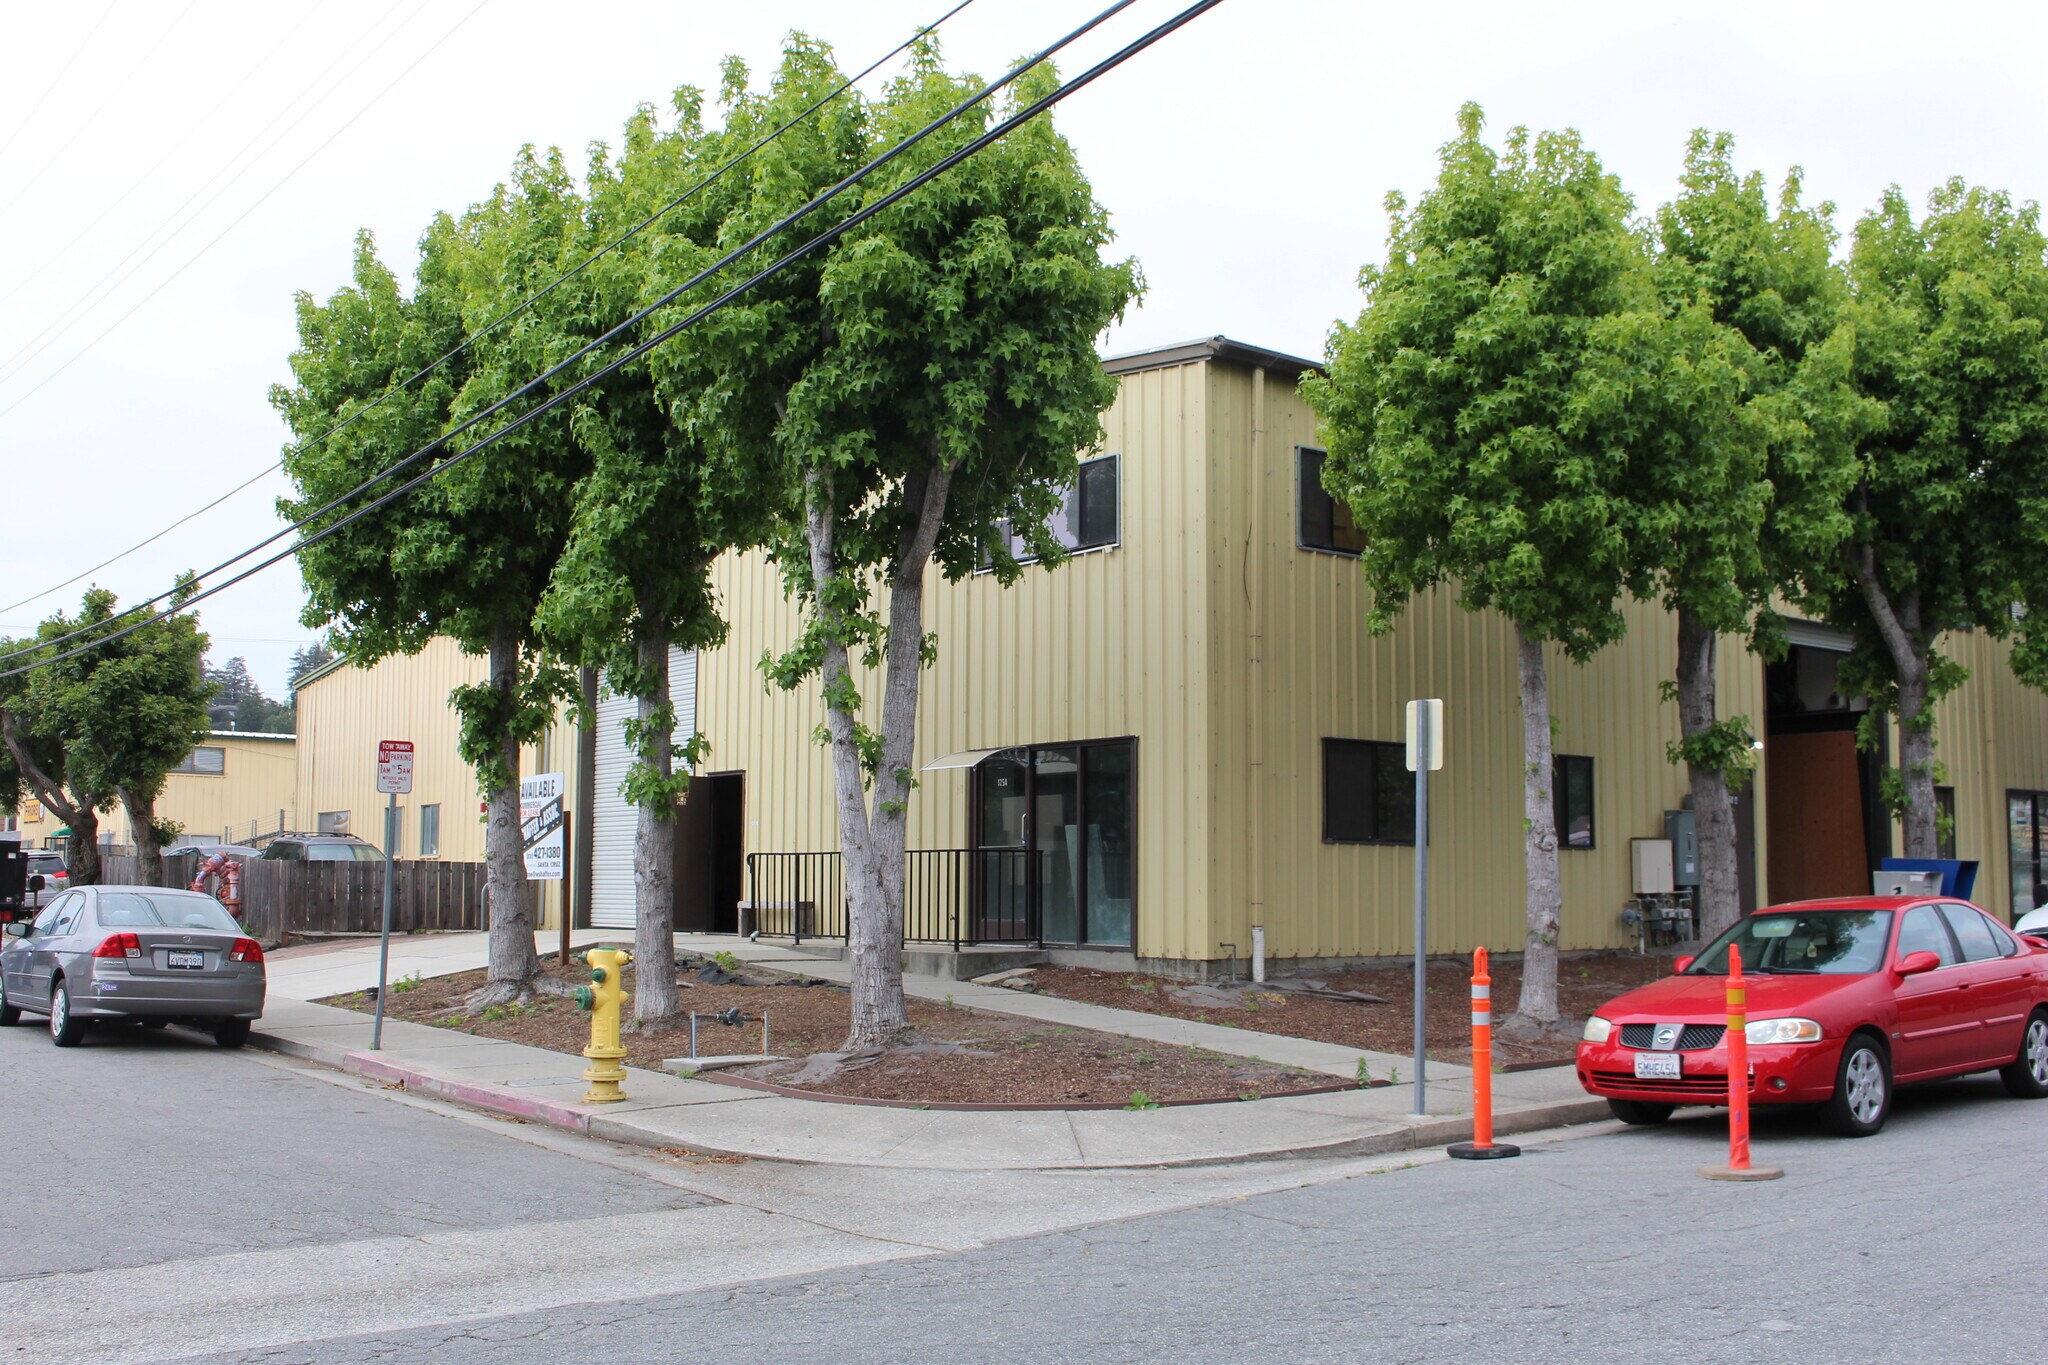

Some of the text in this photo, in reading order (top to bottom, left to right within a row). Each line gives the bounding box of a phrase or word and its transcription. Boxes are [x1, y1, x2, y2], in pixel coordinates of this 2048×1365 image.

[380, 750, 412, 762] NO PARKING
[397, 764, 410, 774] 5AM
[521, 780, 554, 800] AVAILABLE
[534, 846, 560, 858] 427-1380
[1638, 1062, 1676, 1076] 5MHE454
